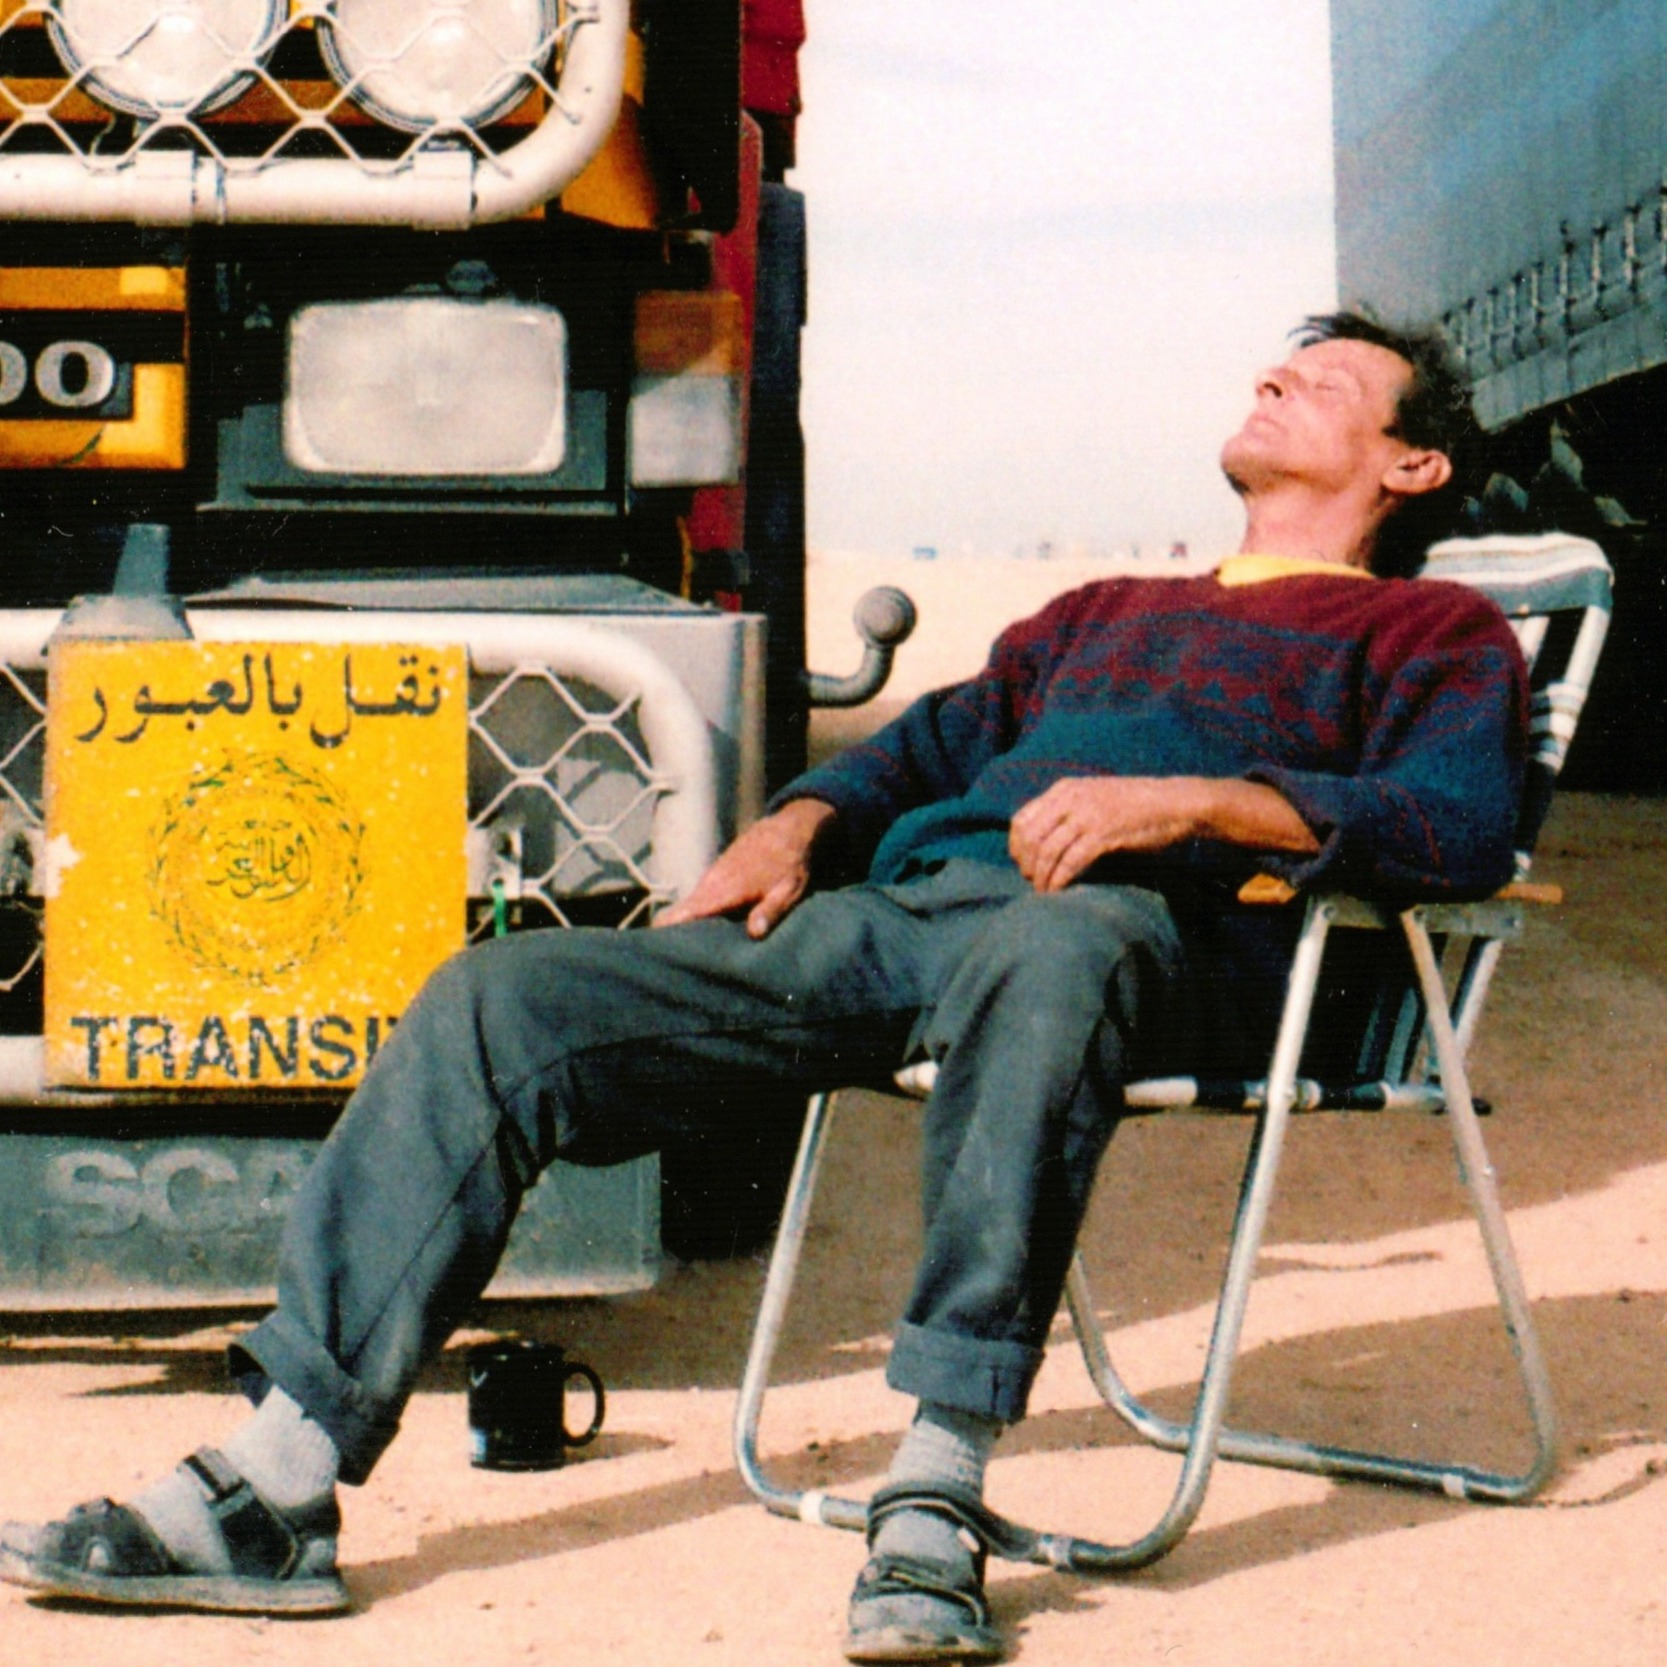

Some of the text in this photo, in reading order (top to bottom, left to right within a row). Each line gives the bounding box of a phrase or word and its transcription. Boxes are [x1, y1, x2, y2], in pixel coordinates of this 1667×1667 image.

[74, 653, 442, 749] نقل بالعبور
[71, 1014, 399, 1081] TRANSI
